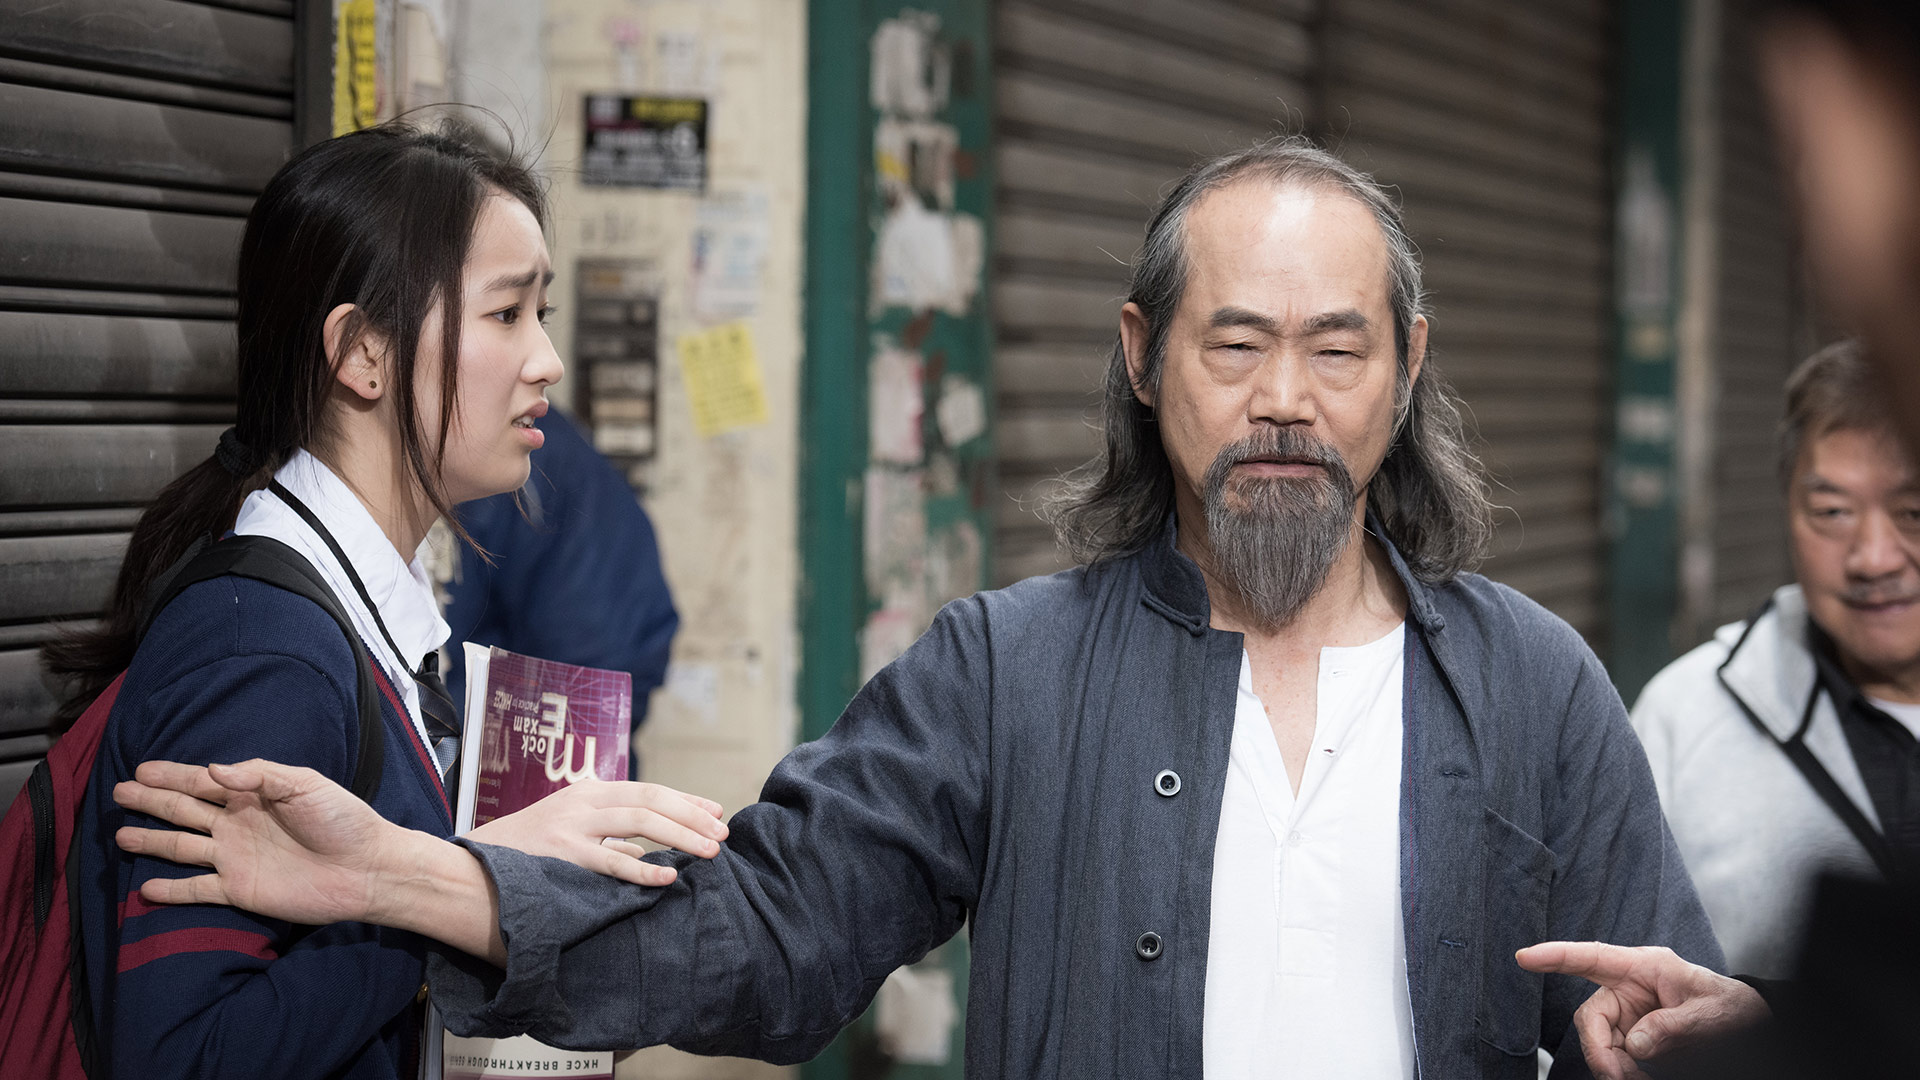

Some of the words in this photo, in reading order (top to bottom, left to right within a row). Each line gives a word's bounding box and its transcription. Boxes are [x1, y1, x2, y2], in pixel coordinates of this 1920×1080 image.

[519, 699, 541, 714] Practice
[513, 691, 568, 740] Exam
[467, 1056, 559, 1070] BREAKTHROUGH
[566, 1058, 599, 1070] HKCE
